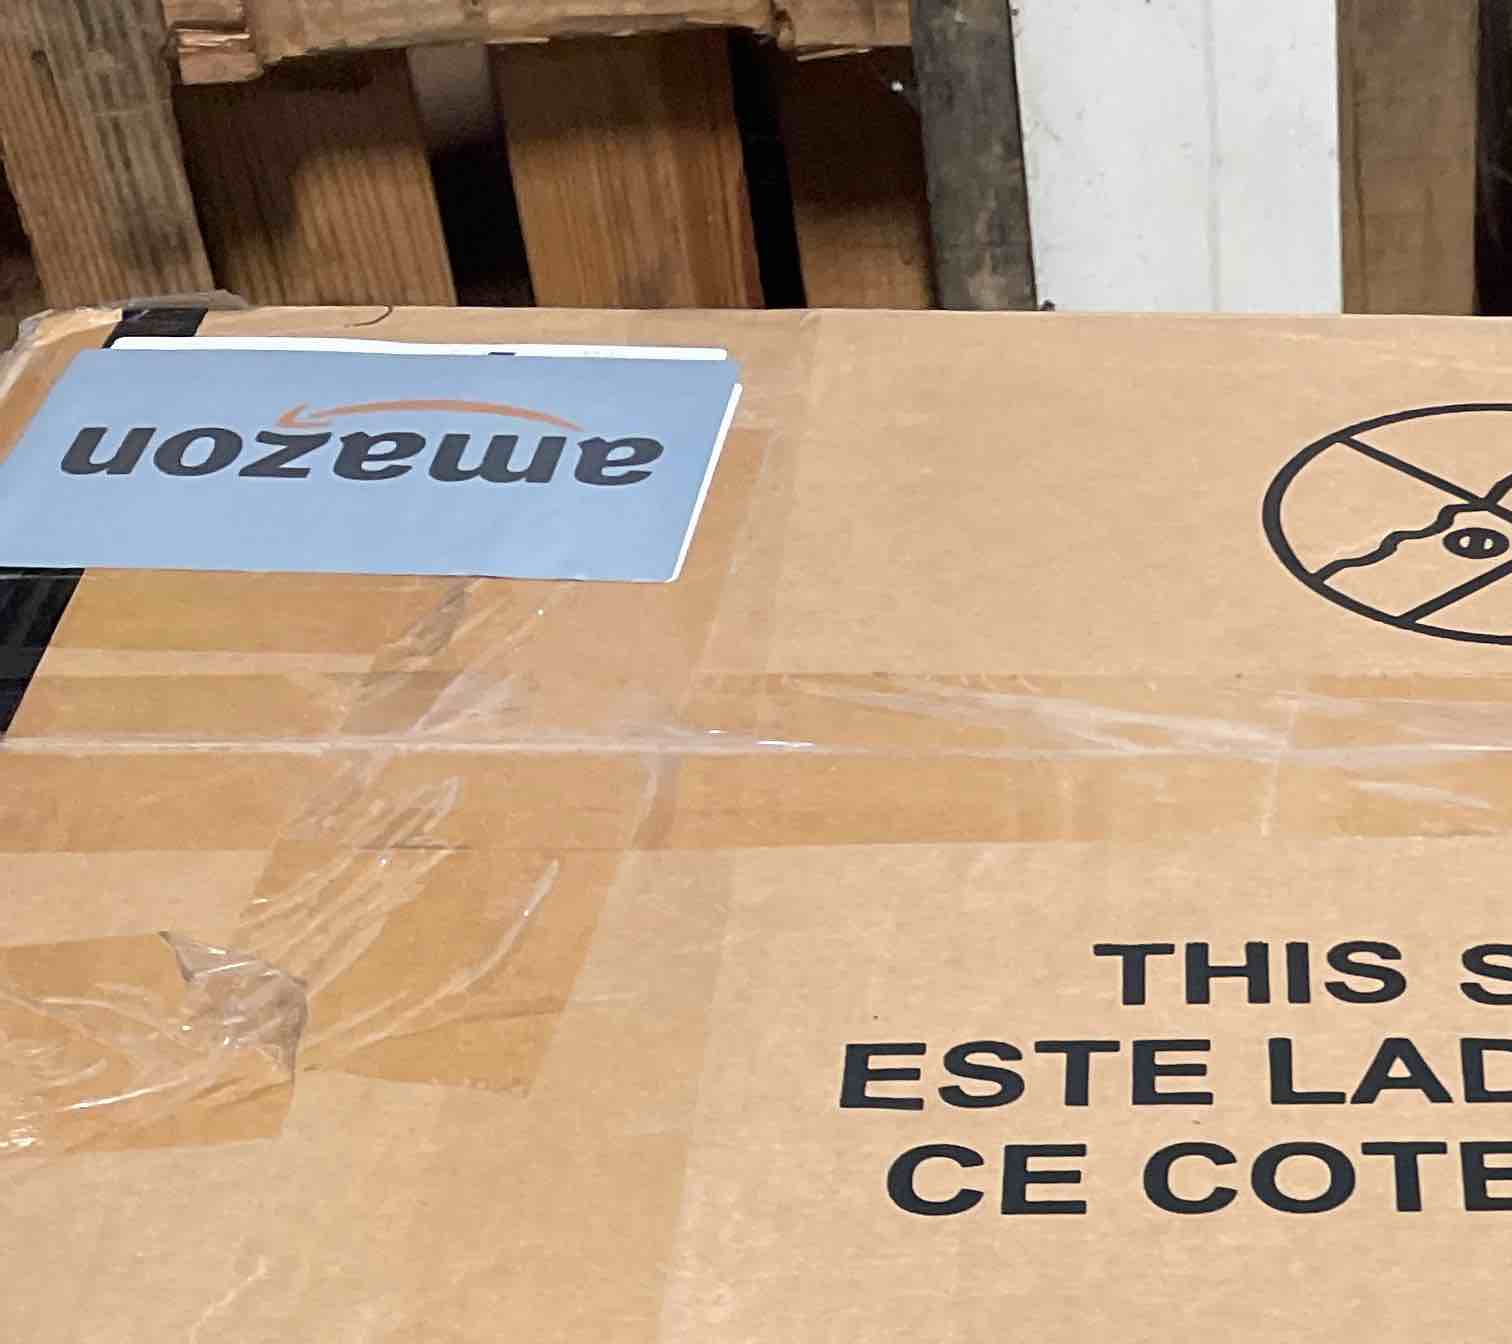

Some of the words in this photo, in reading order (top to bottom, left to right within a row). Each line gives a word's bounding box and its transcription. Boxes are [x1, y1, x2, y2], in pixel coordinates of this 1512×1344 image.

[59, 426, 665, 486] amazon
[1093, 941, 1407, 1005] THIS
[839, 1040, 1214, 1110] ESTE
[887, 1143, 1088, 1215] CE
